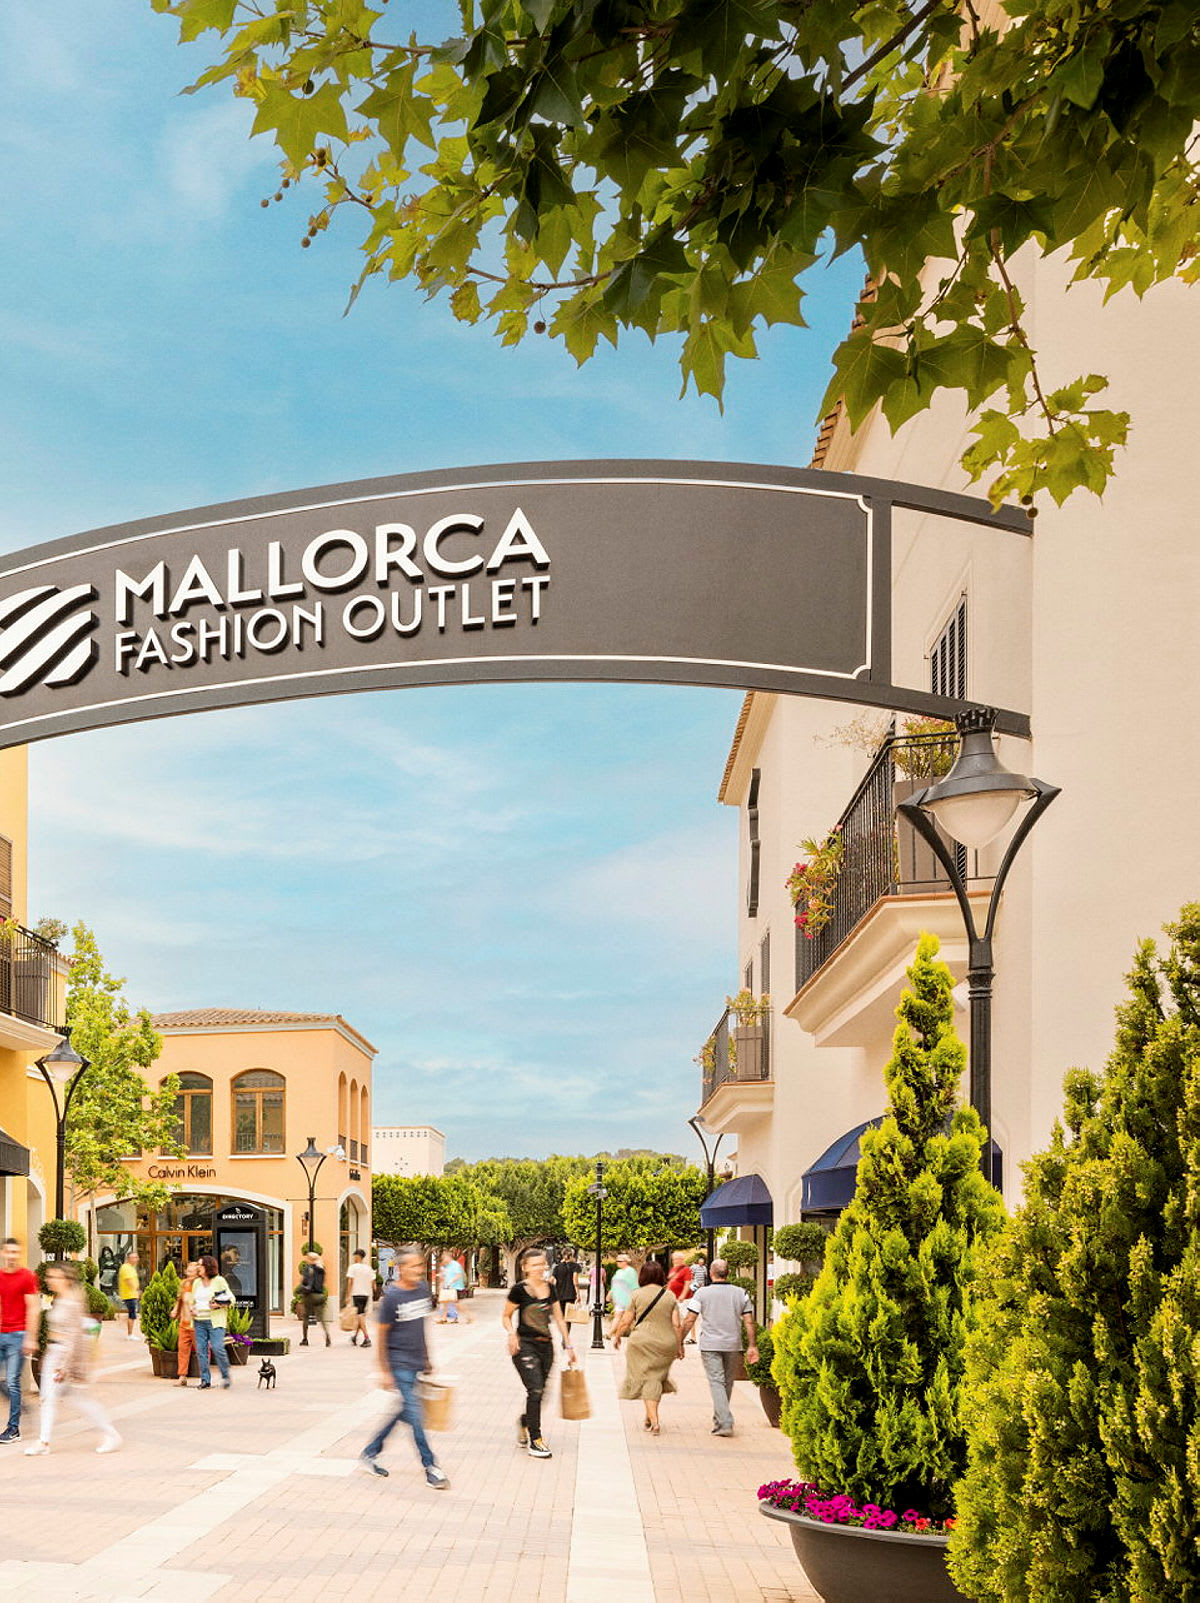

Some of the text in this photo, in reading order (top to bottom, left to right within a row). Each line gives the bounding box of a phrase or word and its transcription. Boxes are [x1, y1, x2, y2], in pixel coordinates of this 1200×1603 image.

[115, 507, 550, 622] MALLORCA
[115, 575, 550, 673] FASHION OUTLET
[148, 1165, 216, 1178] Calvin Klein
